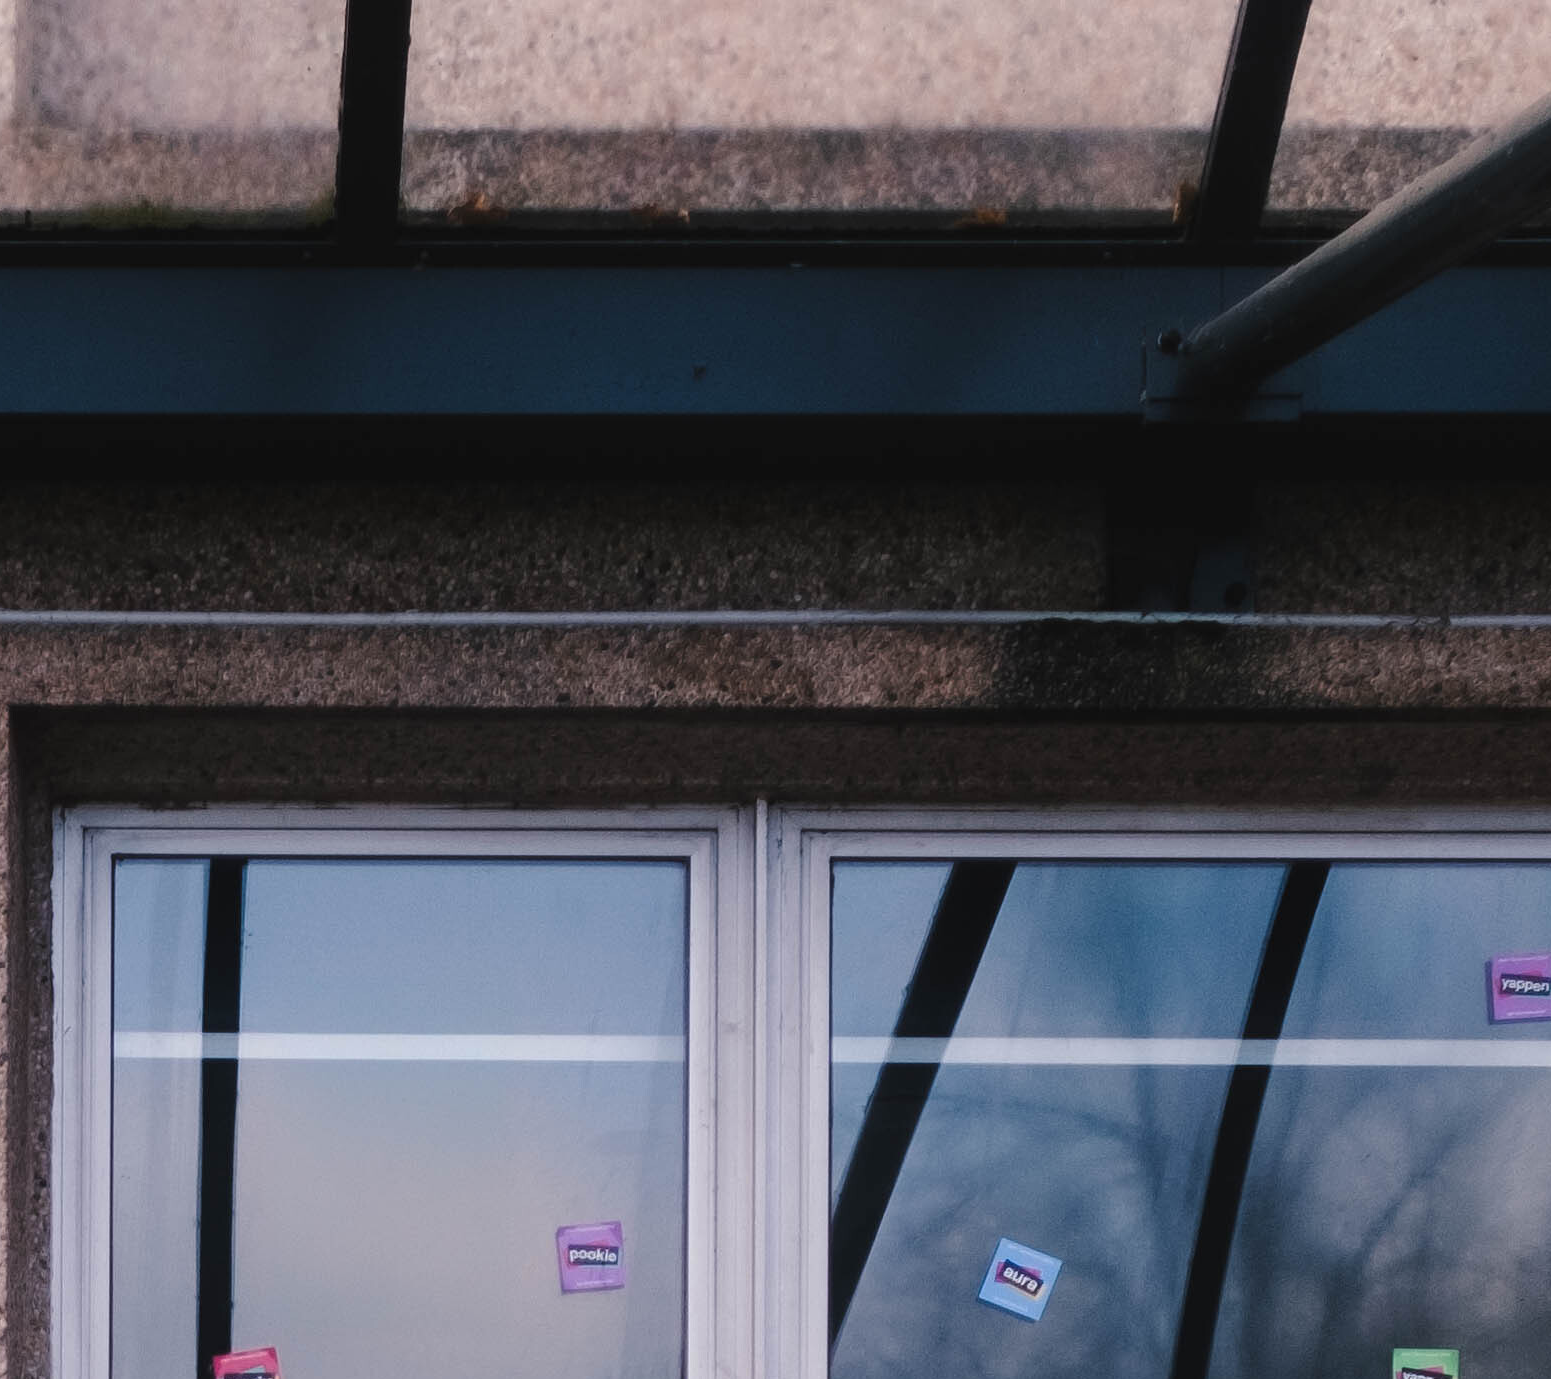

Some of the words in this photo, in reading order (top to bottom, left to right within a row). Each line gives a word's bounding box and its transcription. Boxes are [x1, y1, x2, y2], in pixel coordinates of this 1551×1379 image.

[1502, 978, 1549, 993] yappen
[569, 1248, 617, 1262] pookie
[1003, 1267, 1038, 1292] aura
